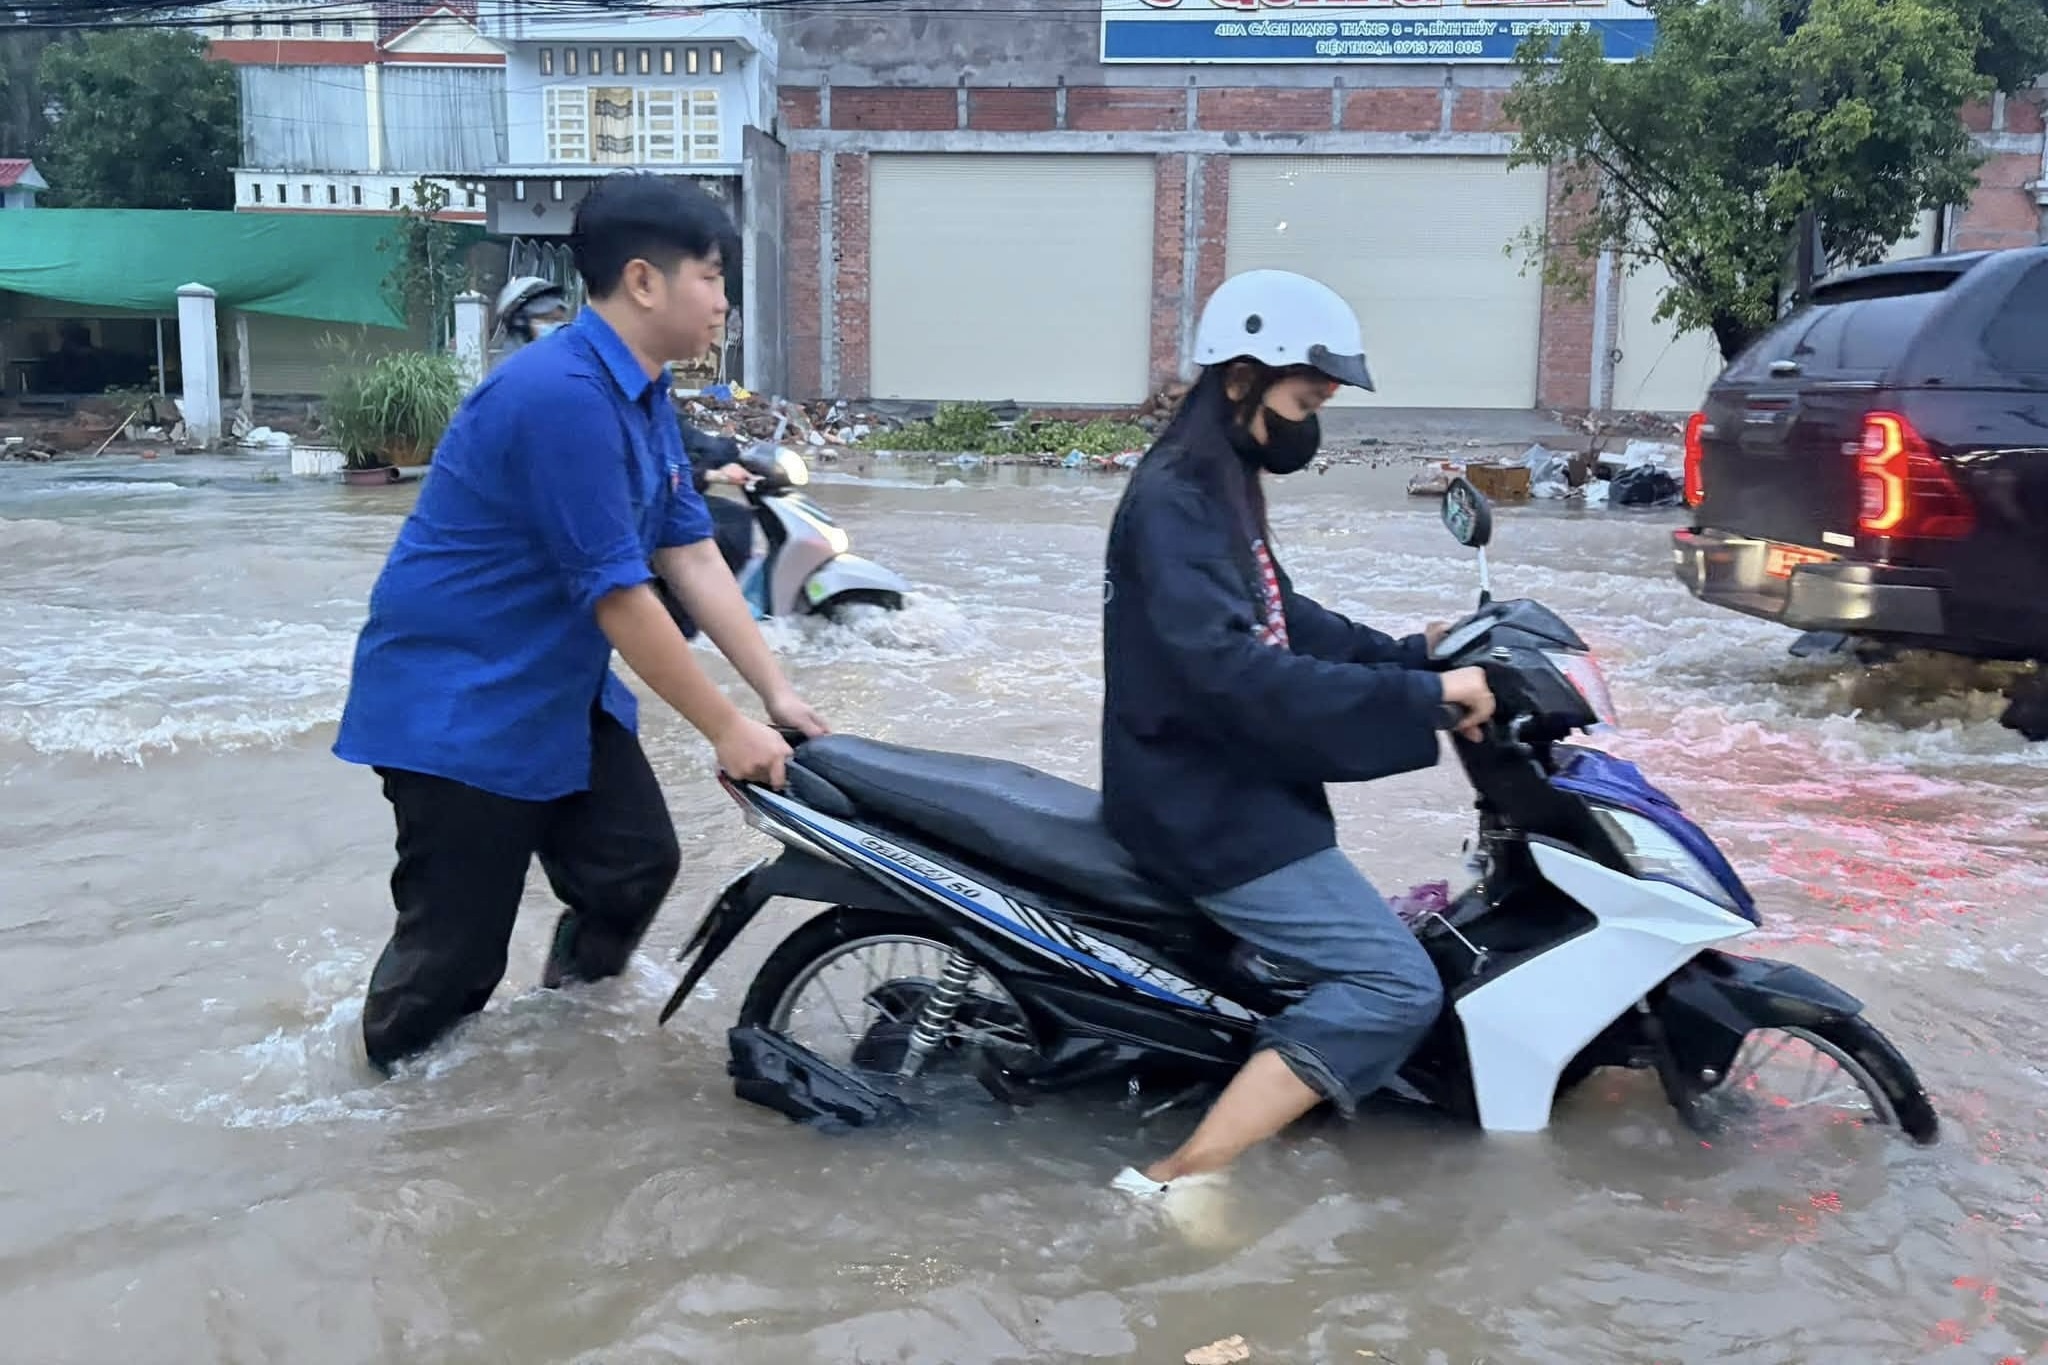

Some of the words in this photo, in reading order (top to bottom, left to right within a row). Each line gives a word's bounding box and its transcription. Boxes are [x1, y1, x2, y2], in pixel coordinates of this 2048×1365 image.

[1248, 20, 1290, 36] CÁCH
[1291, 22, 1337, 37] MẠNG
[1340, 20, 1389, 36] THÁNG
[1392, 22, 1402, 36] 8
[1316, 39, 1348, 55] ĐIỆN
[1428, 40, 1454, 54] 721
[946, 882, 981, 898] 50
